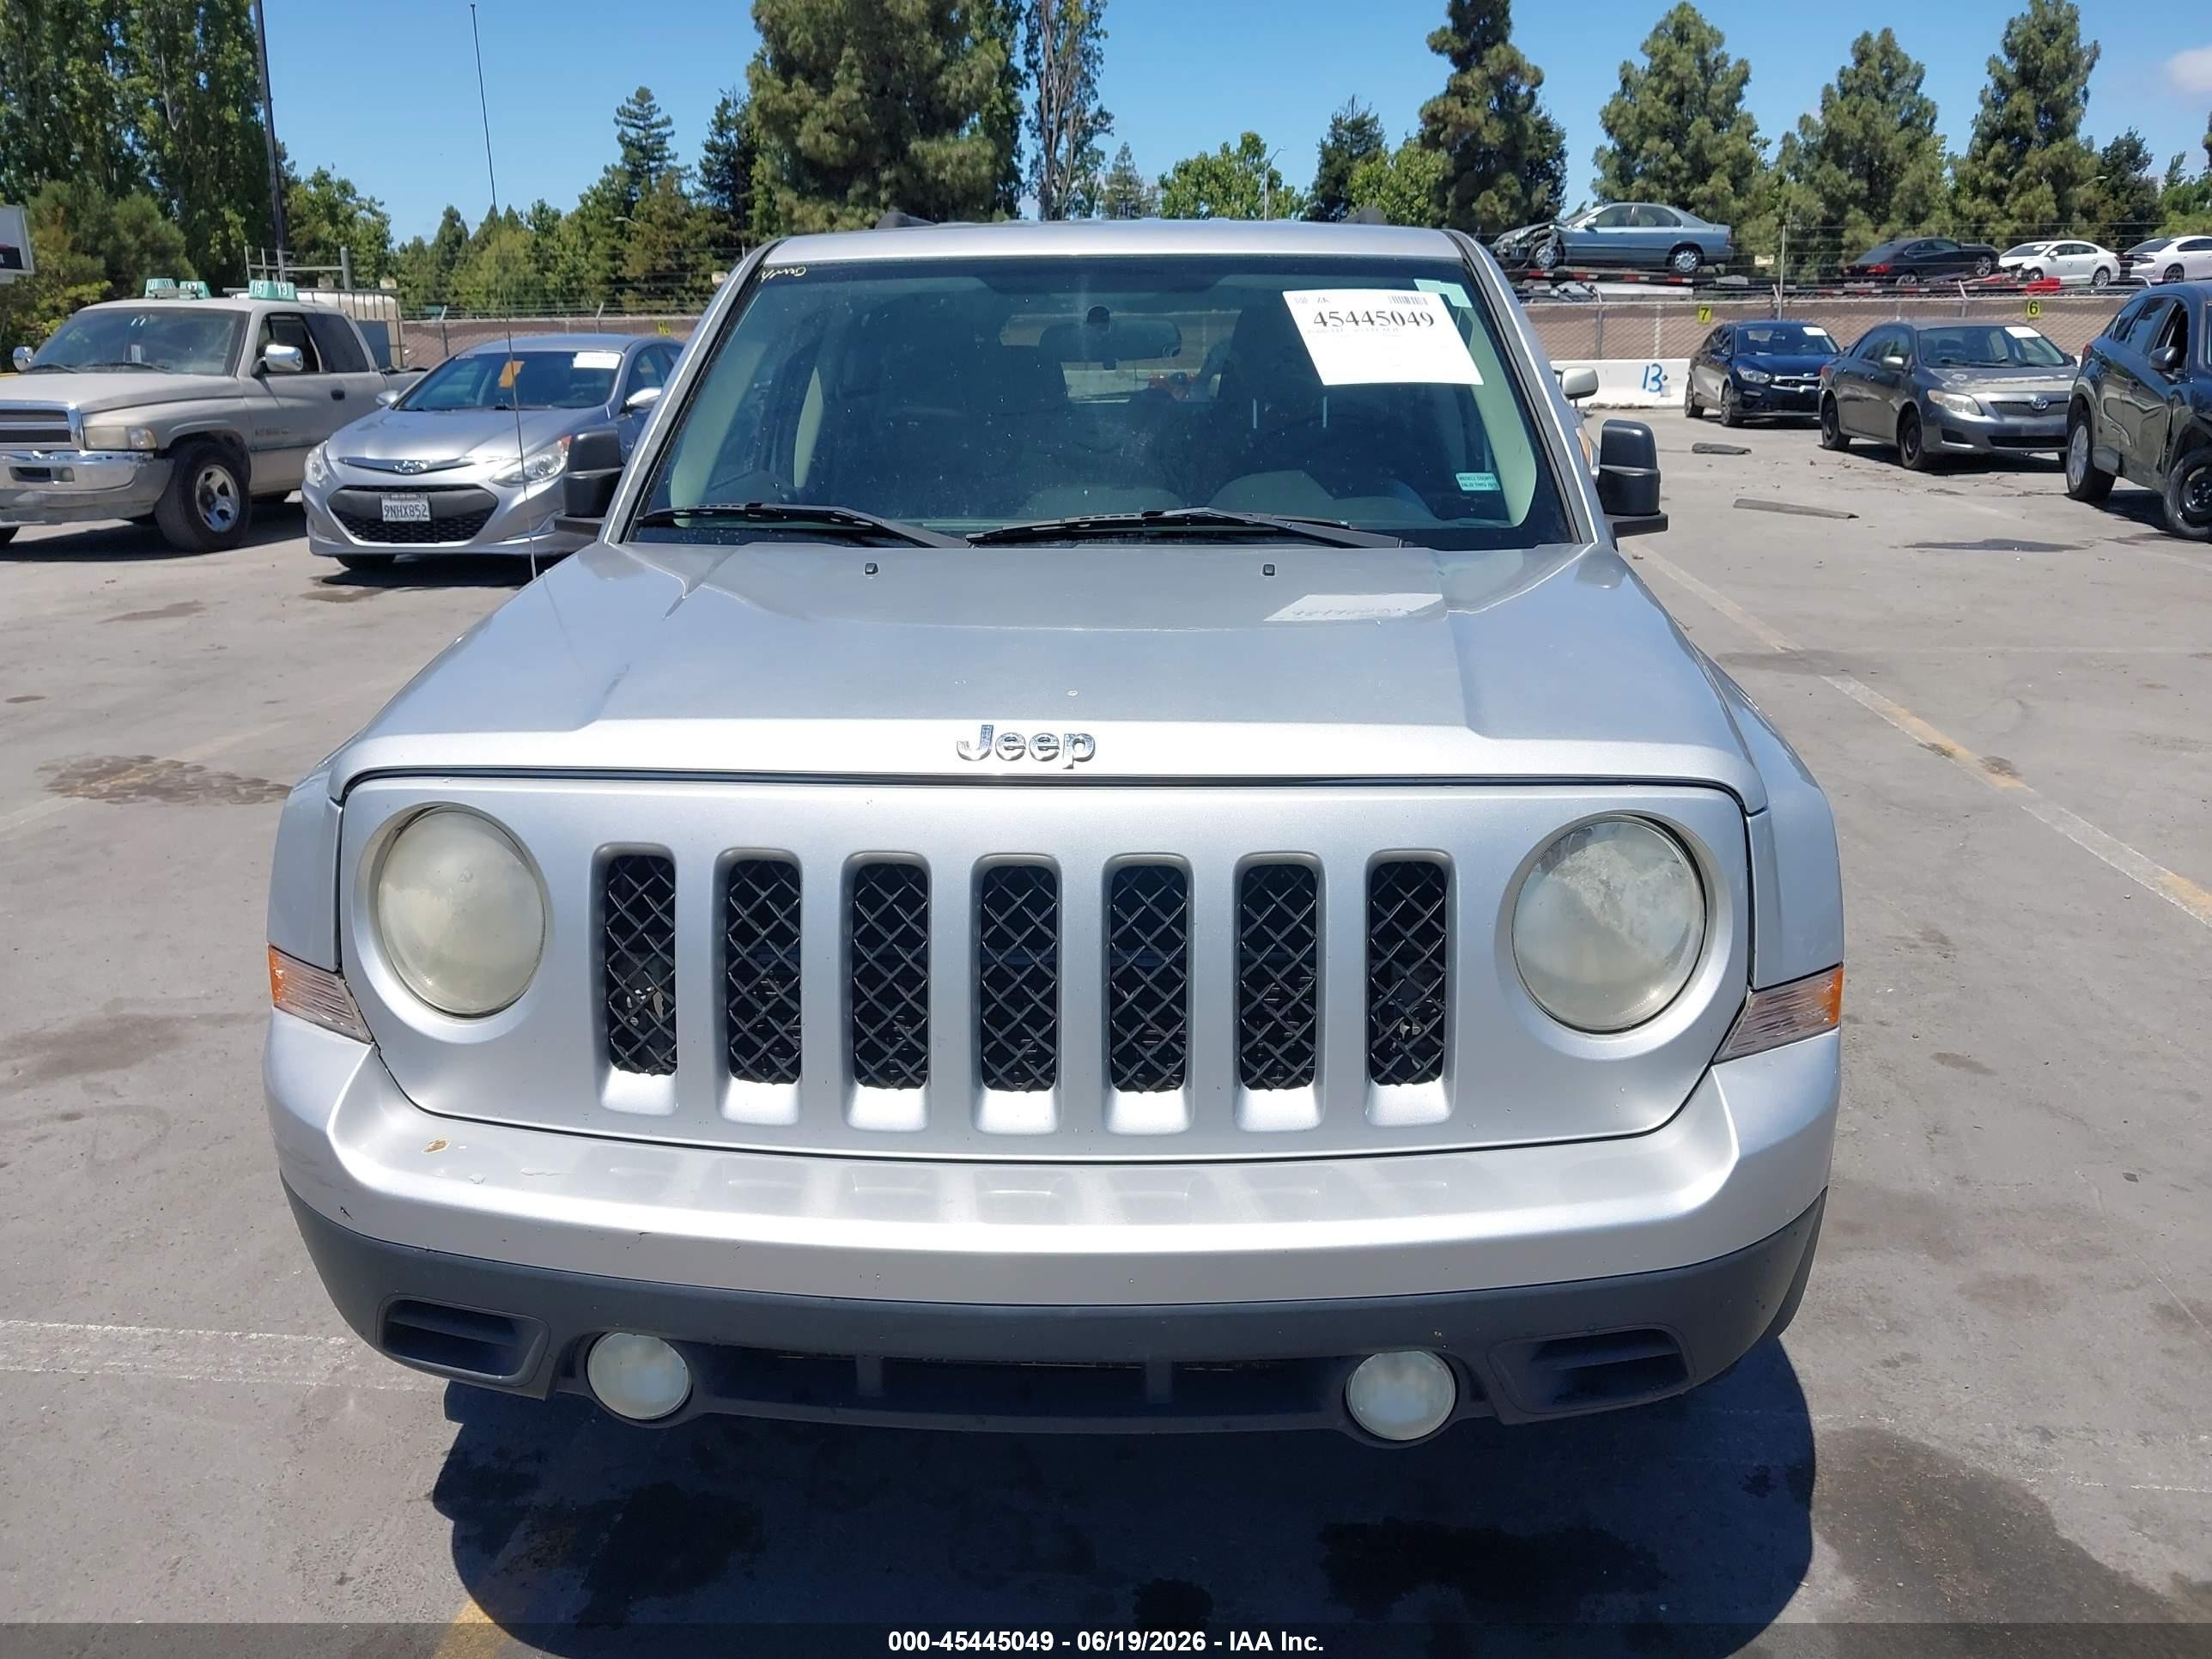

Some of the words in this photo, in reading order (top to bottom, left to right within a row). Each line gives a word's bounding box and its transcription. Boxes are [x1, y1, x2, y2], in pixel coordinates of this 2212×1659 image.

[1700, 307, 1710, 320] 7
[2029, 301, 2038, 315] 6
[1313, 310, 1435, 328] 45445049
[956, 724, 1096, 770] Jeep
